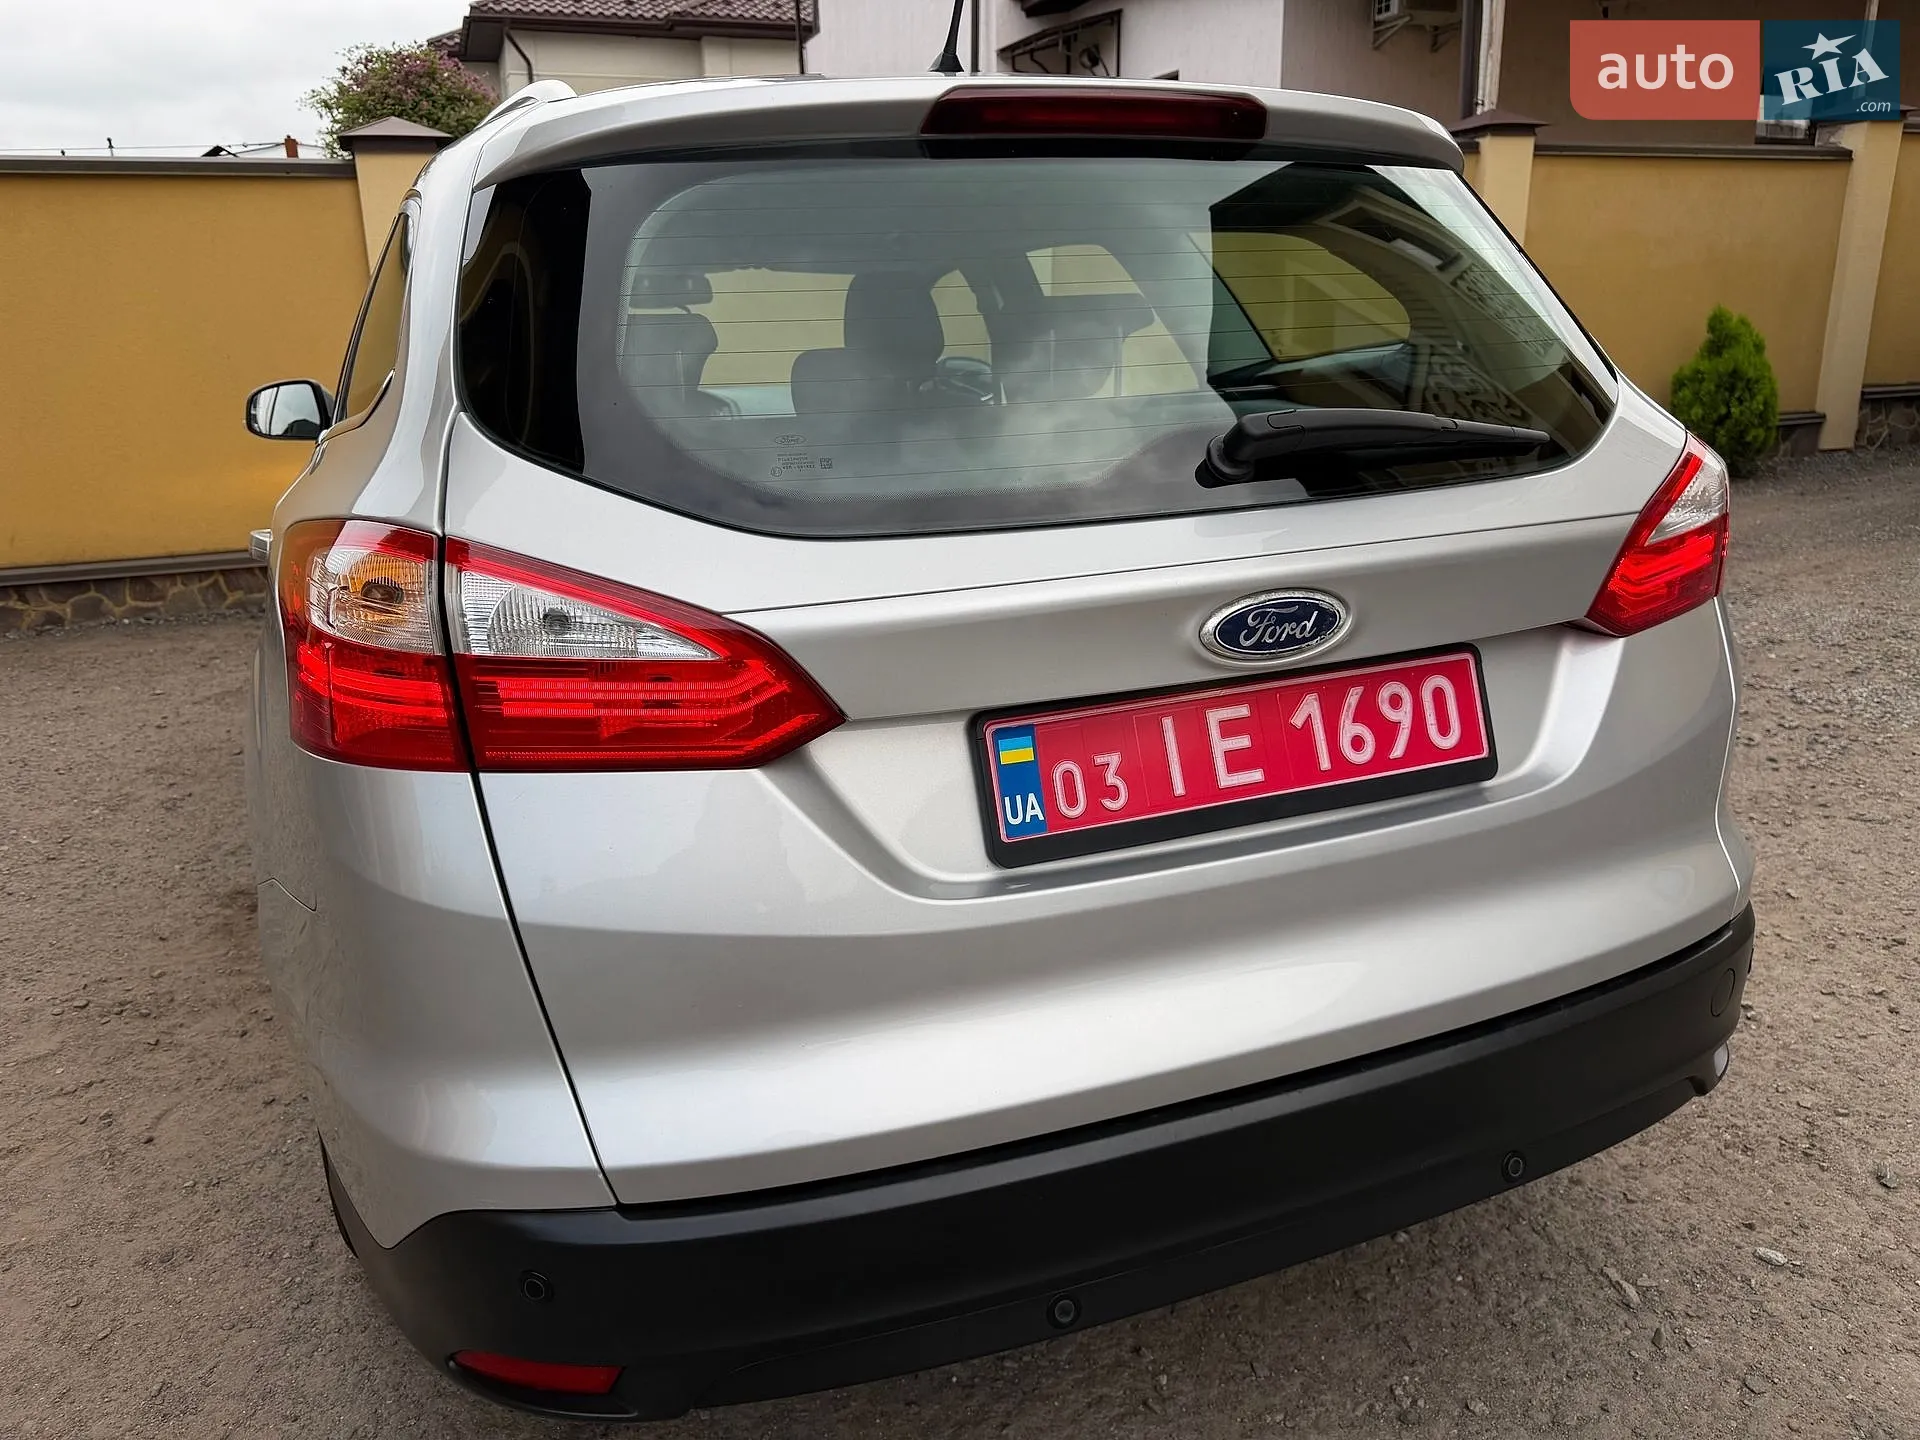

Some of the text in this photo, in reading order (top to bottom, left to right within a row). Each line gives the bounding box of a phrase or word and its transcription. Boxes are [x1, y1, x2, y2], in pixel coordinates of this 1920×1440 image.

[1238, 604, 1319, 647] Ford
[1052, 675, 1461, 819] 03 IE 1690
[1004, 793, 1045, 825] UA
